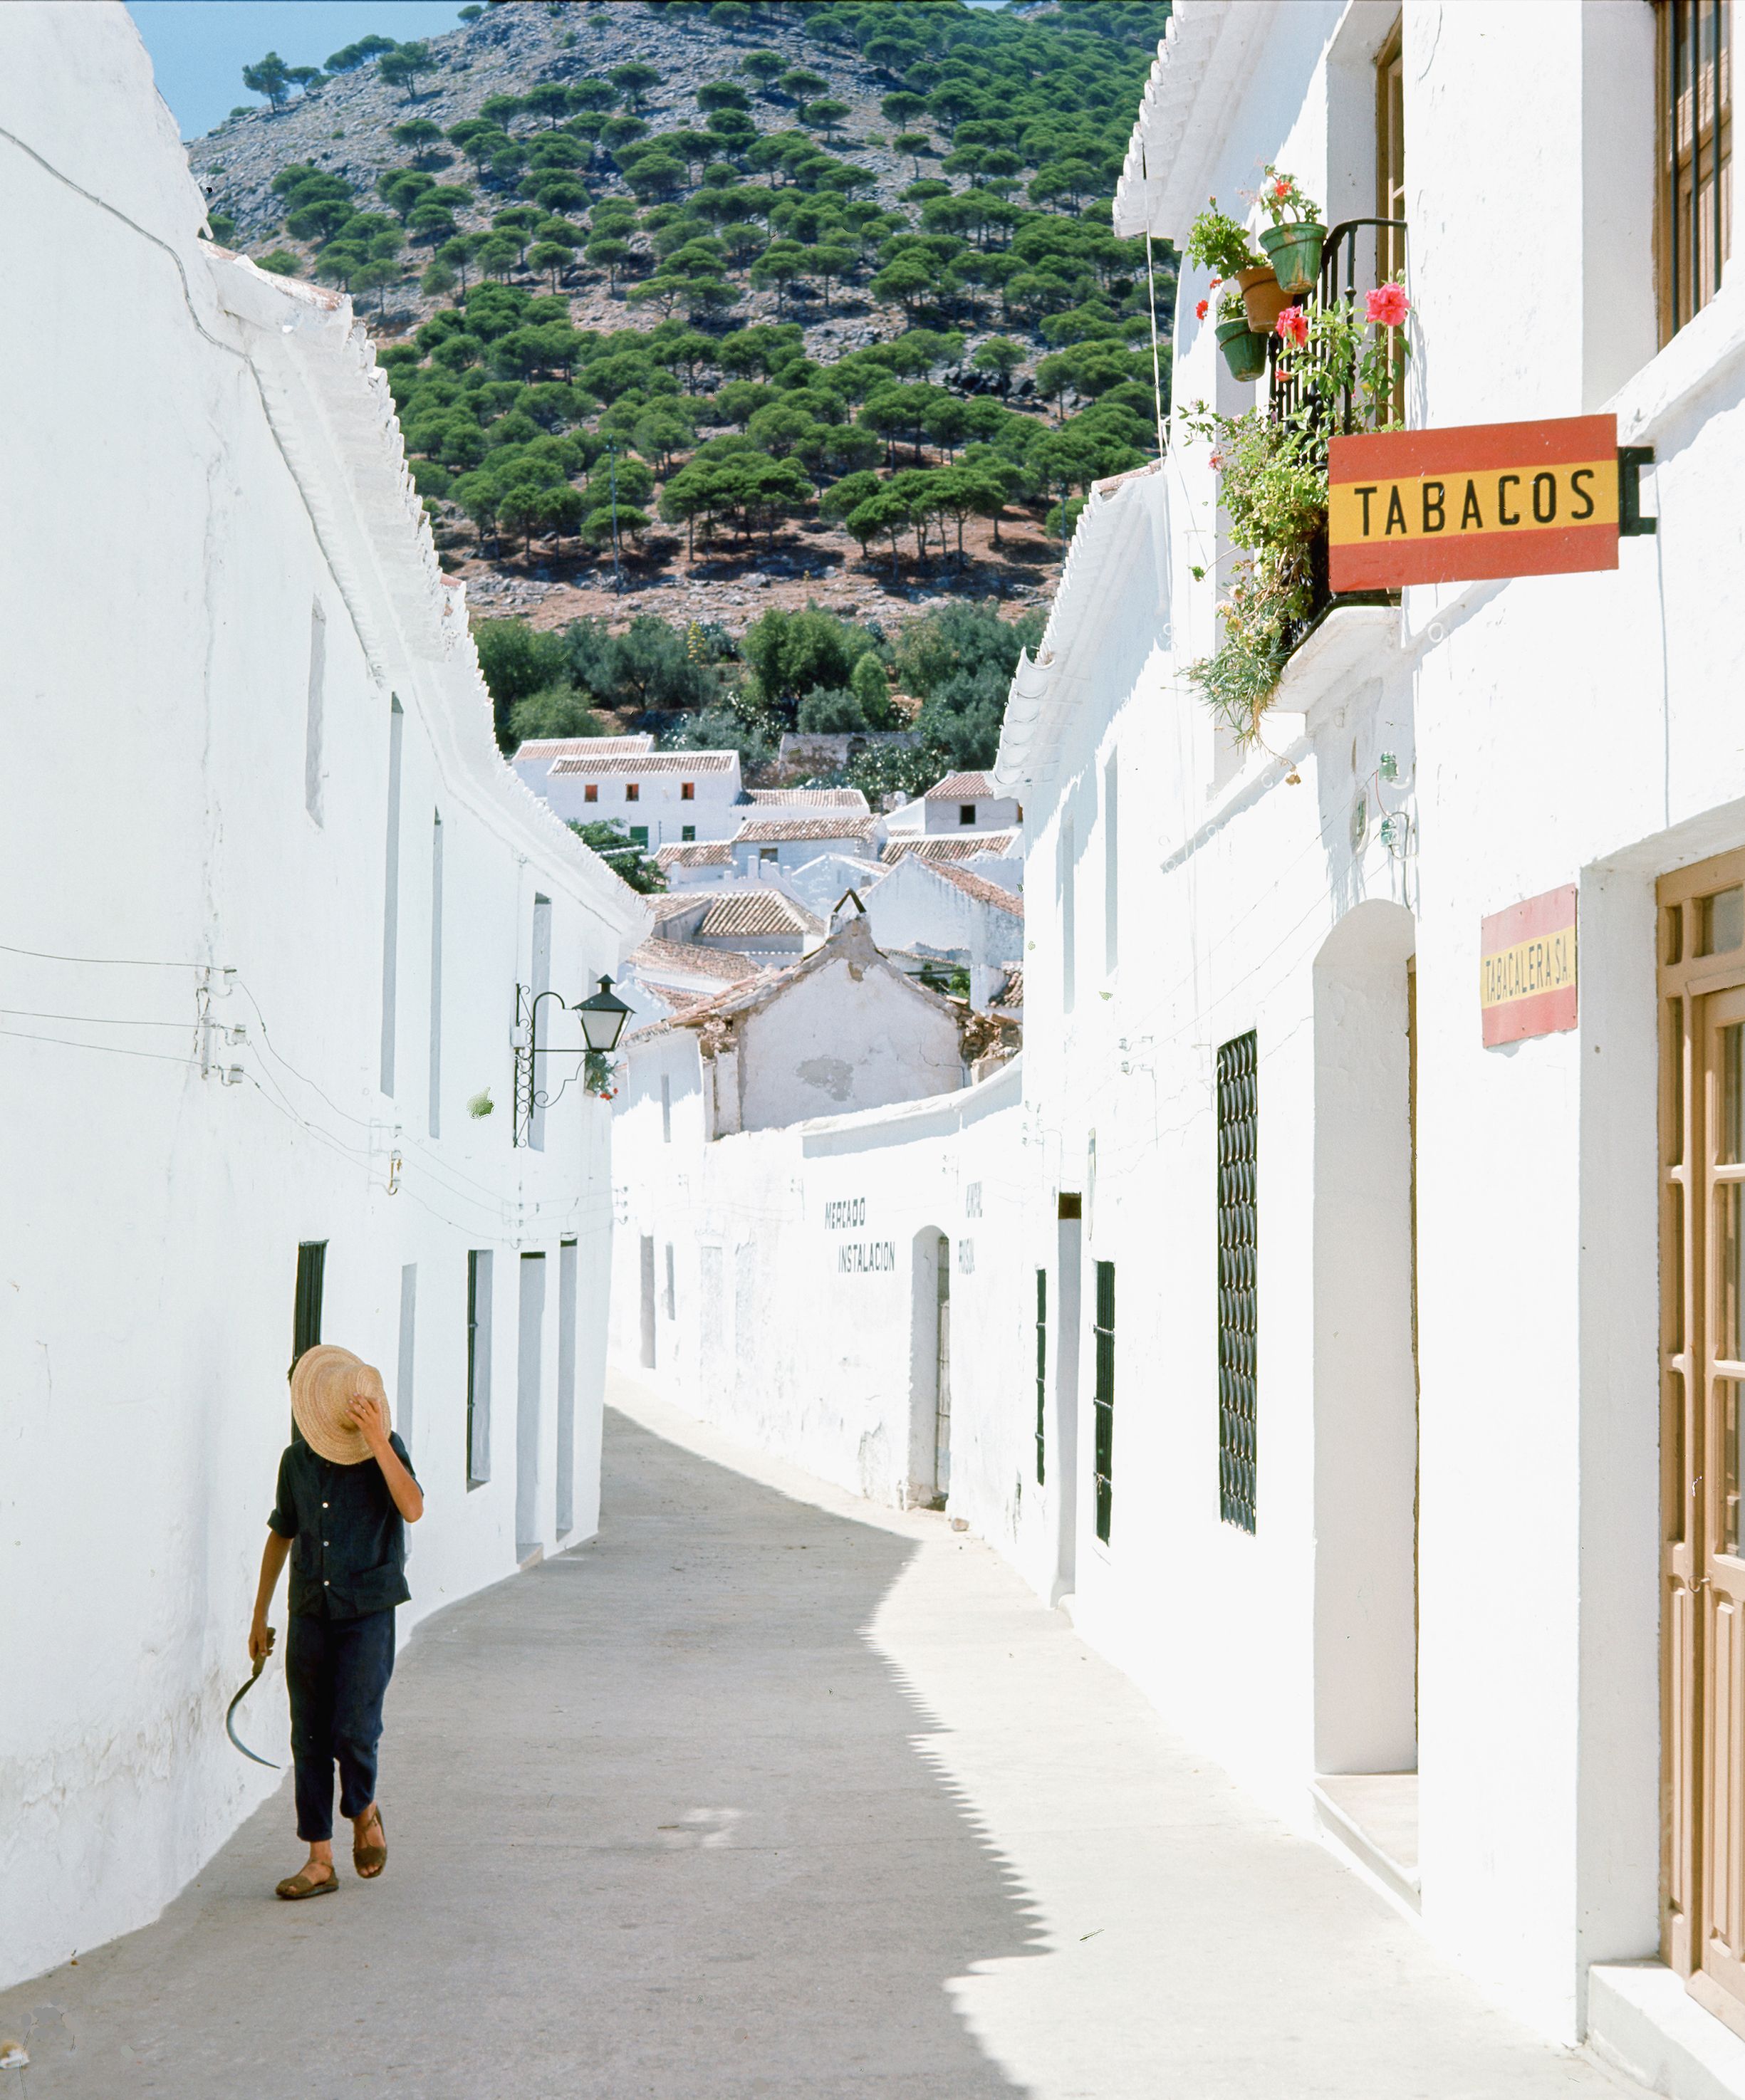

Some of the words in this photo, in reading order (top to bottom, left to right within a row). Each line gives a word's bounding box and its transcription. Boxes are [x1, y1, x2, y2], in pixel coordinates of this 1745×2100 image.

[1354, 469, 1595, 536] TABACOS
[1486, 941, 1552, 1002] TABACALERA
[825, 1197, 865, 1229] MERCADO
[838, 1241, 895, 1273] INSTALACION
